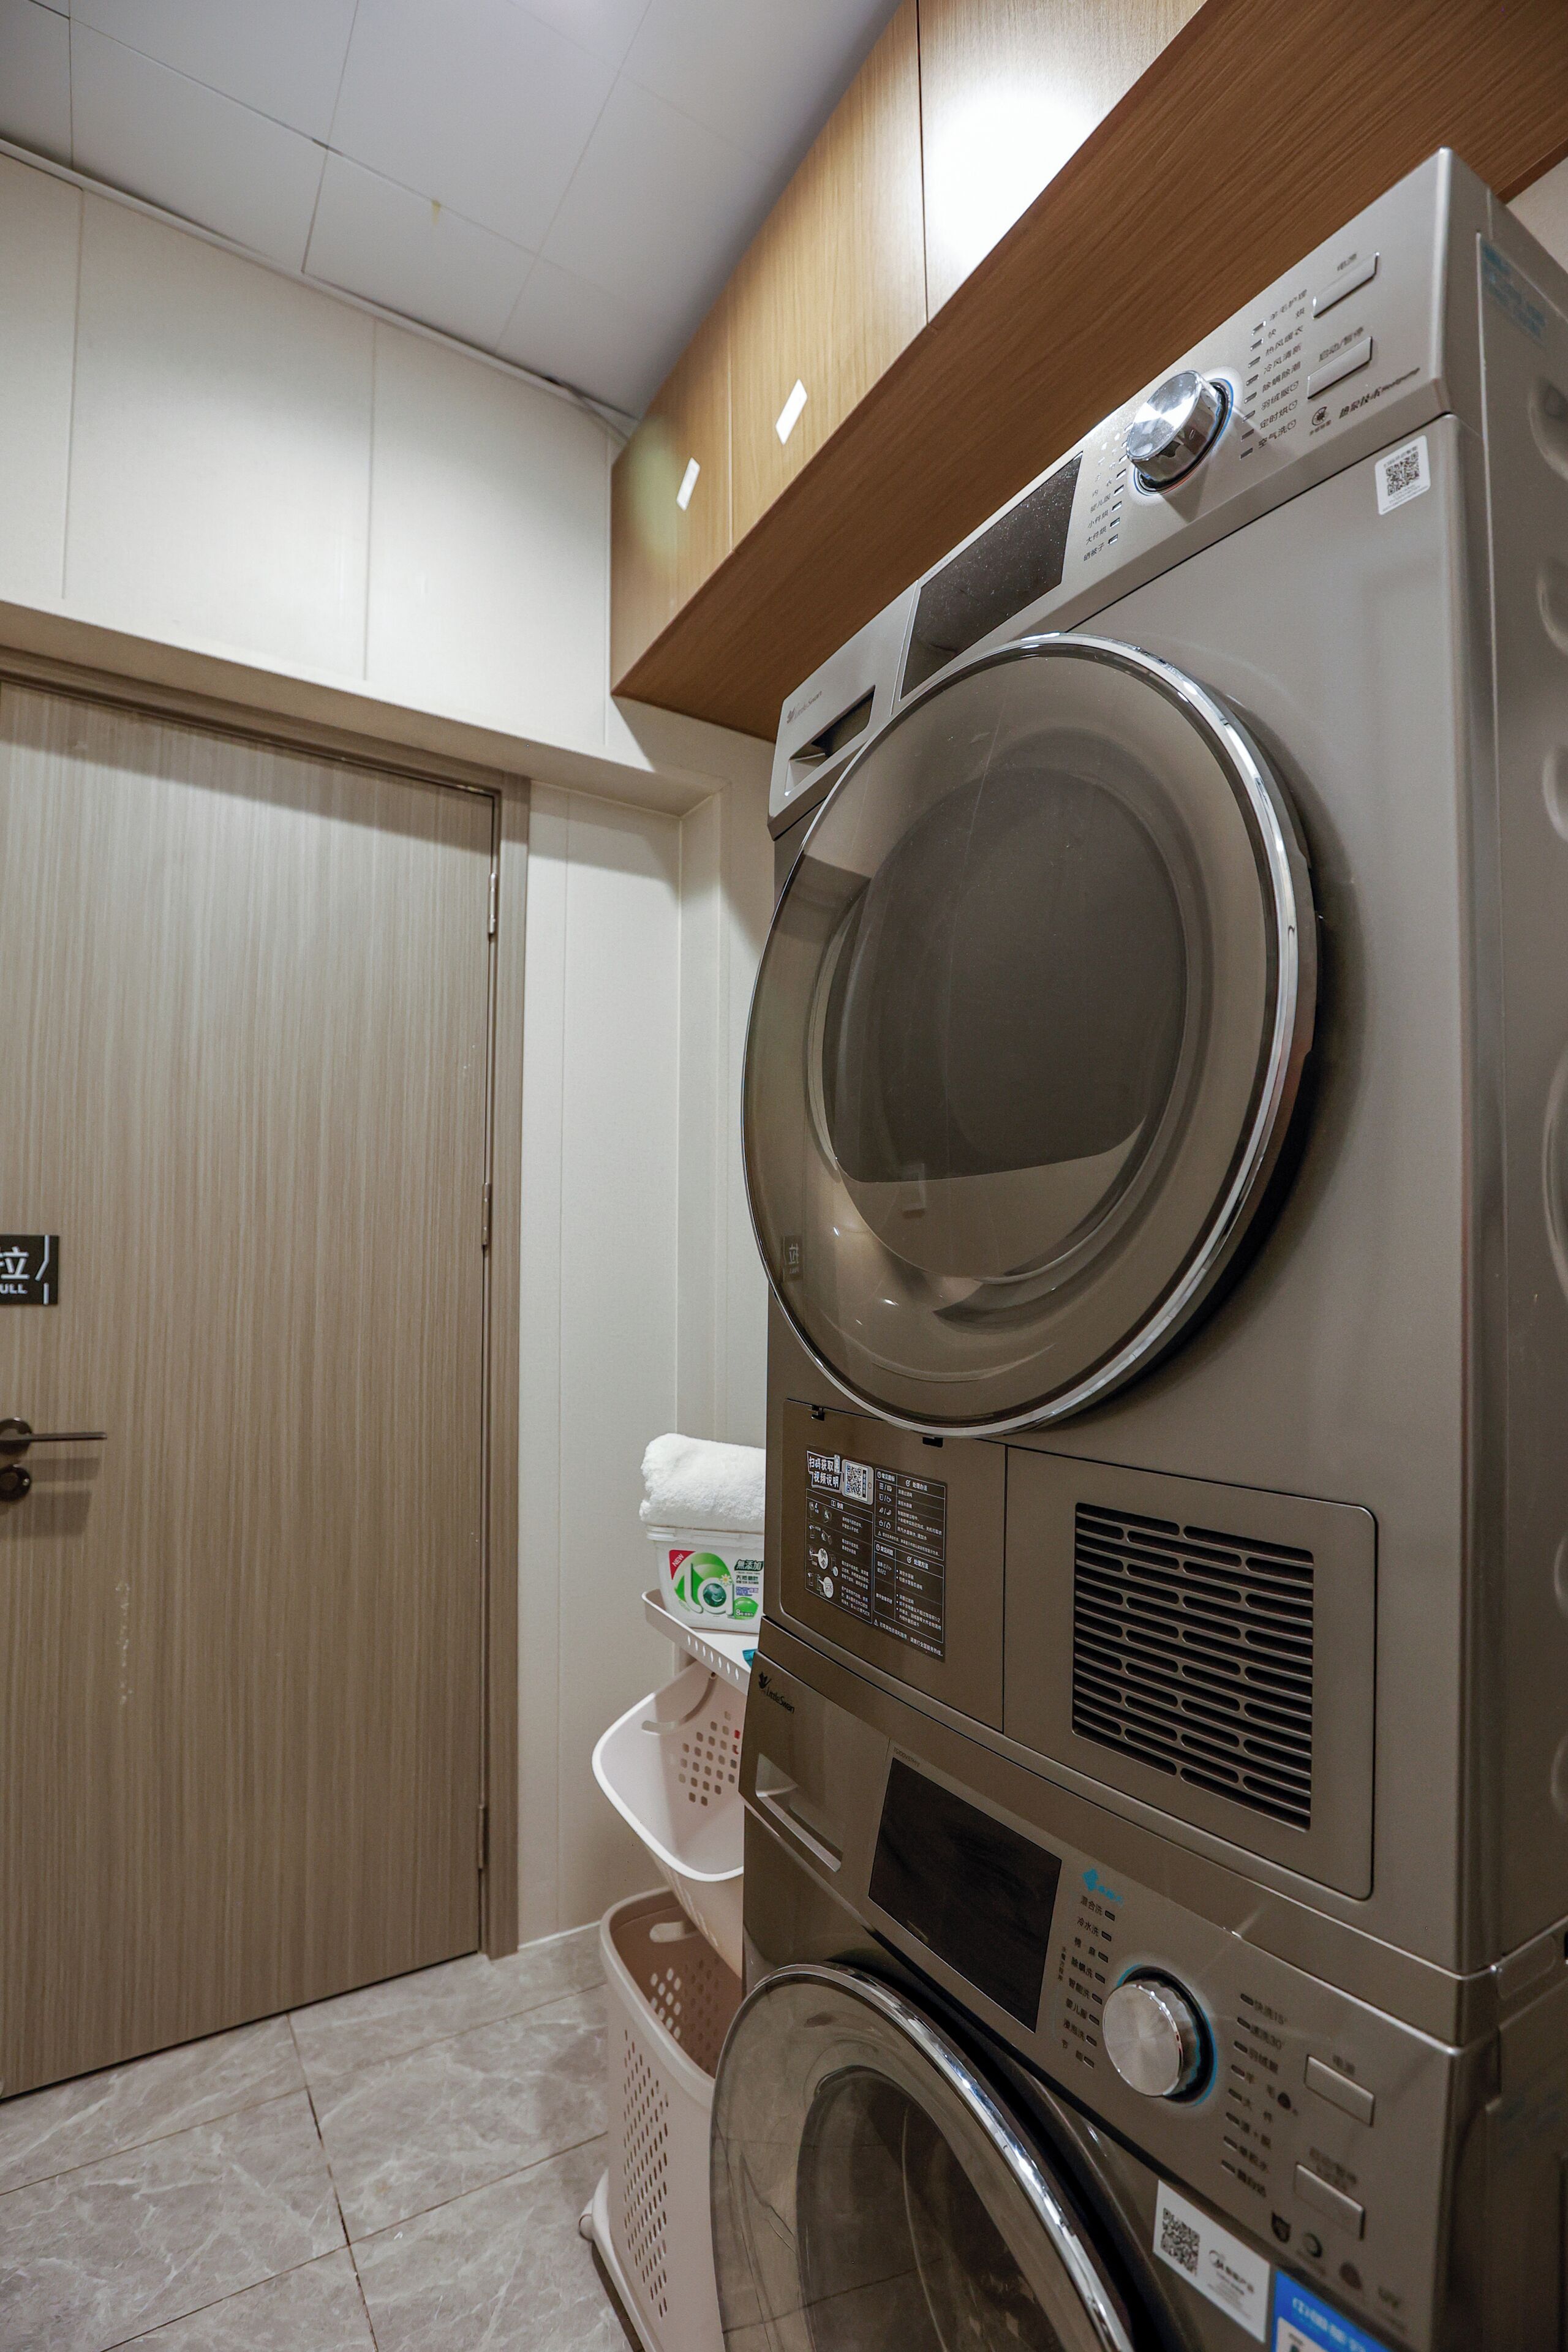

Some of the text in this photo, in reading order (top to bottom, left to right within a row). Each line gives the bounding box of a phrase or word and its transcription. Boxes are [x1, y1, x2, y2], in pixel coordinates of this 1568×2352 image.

[1260, 406, 1287, 429] 定时烘
[809, 1457, 834, 1472] 扫码获取
[814, 1471, 839, 1488] 视频说明
[673, 1553, 684, 1567] NEW
[736, 1559, 762, 1570] 無添加
[766, 1687, 795, 1714] LittleSwan
[1080, 1895, 1102, 1916] 混合洗
[1077, 1916, 1099, 1937] 冷水洗
